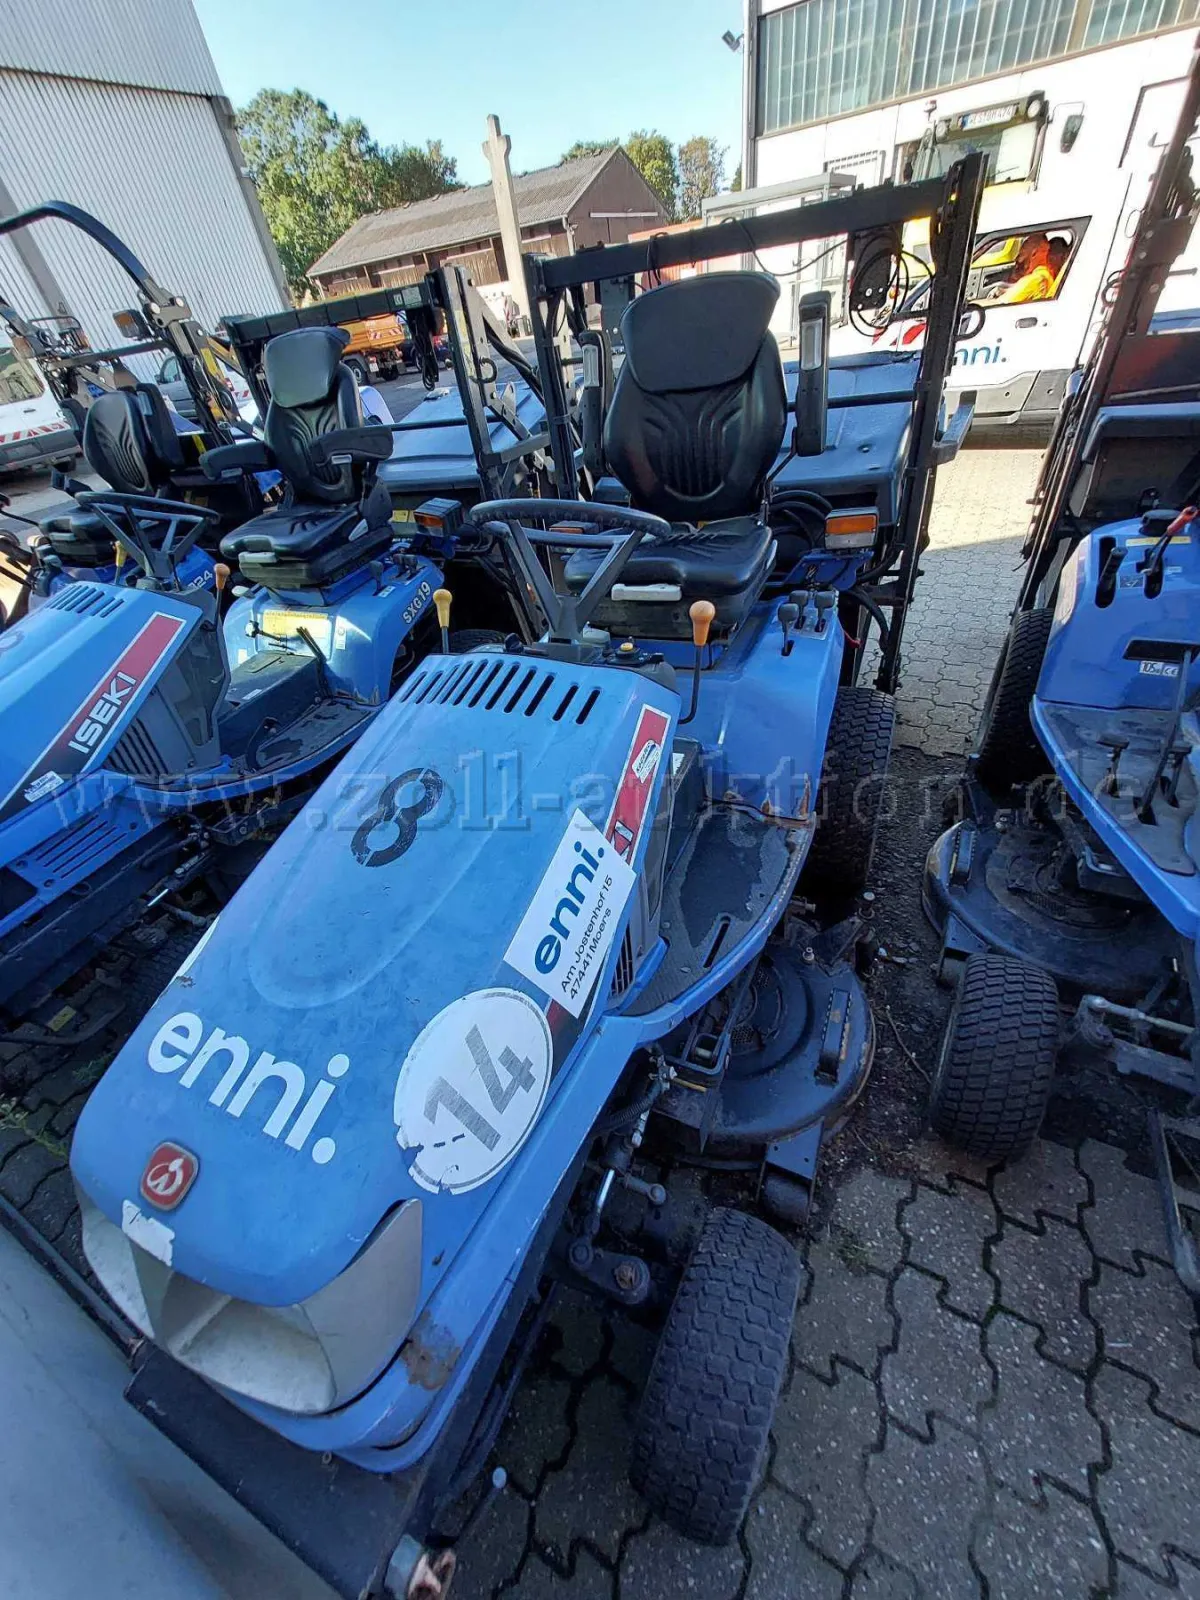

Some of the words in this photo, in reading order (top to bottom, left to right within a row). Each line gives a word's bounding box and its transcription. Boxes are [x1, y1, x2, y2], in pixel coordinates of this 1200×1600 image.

[955, 338, 1007, 366] nni.
[68, 671, 136, 754] ISEKI
[350, 767, 444, 868] 8
[534, 841, 605, 975] enni.
[561, 965, 577, 993] Am
[575, 890, 606, 964] Jostenhof
[602, 874, 613, 893] 15
[570, 953, 593, 1000] 47441
[589, 908, 612, 953] Moers
[148, 1012, 350, 1165] enni.
[424, 1024, 537, 1152] 14
